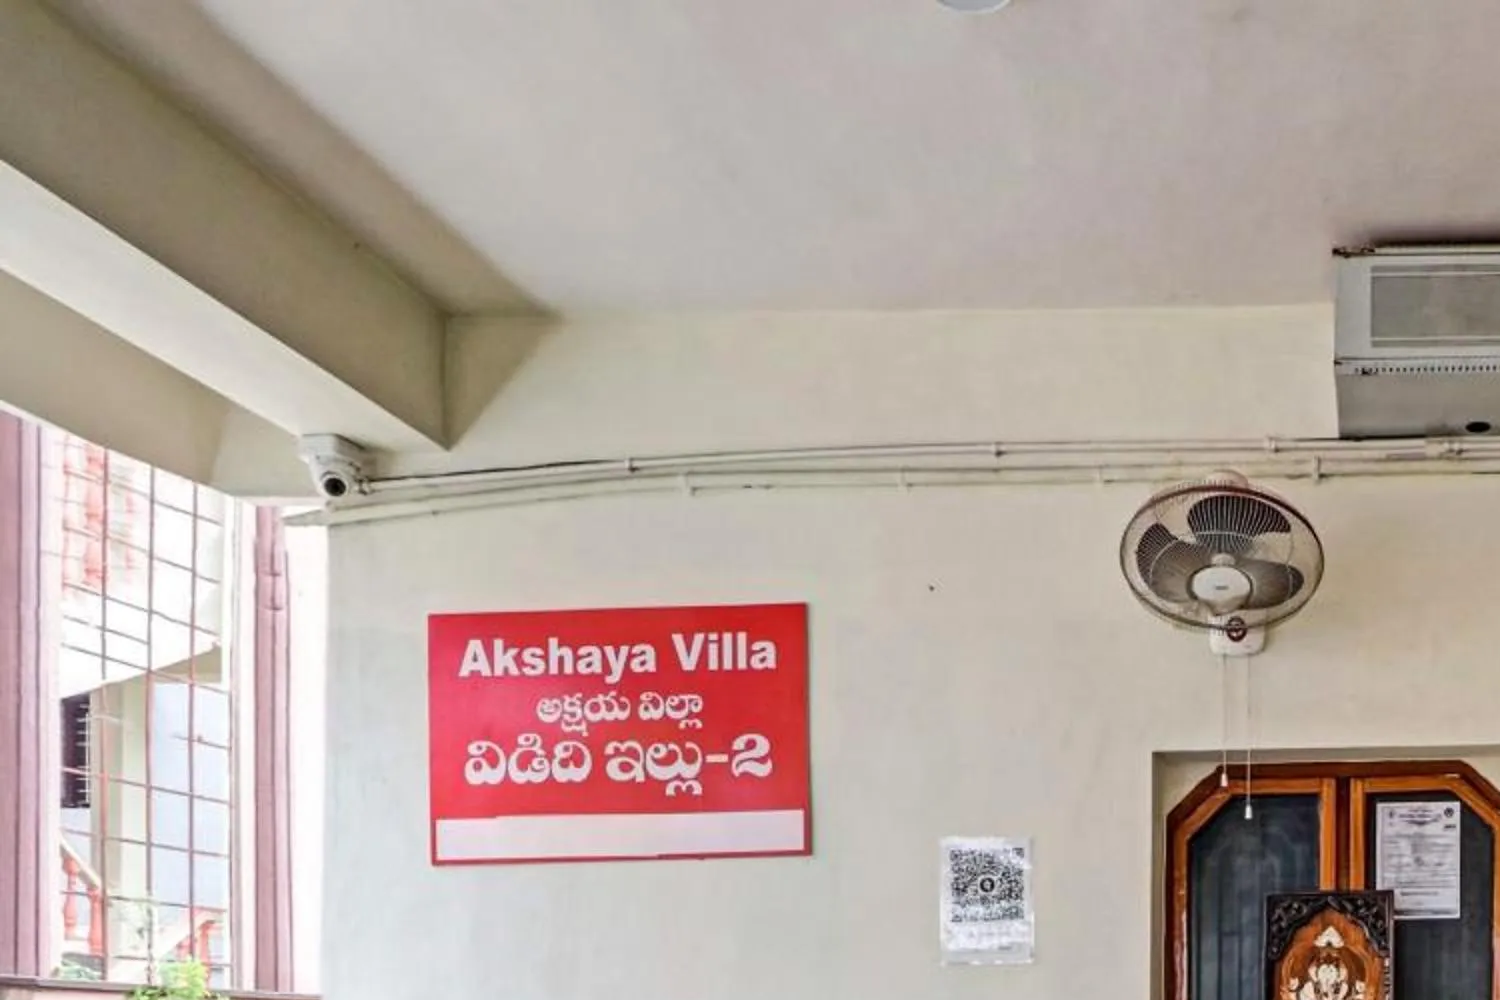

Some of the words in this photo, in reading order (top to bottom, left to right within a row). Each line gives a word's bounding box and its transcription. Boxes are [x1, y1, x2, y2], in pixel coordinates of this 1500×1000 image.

[458, 636, 657, 684] Akshaya
[671, 631, 778, 672] Villa
[535, 692, 631, 737] అక్షయ
[637, 691, 703, 729] విల్లా
[464, 733, 592, 785] విడిది
